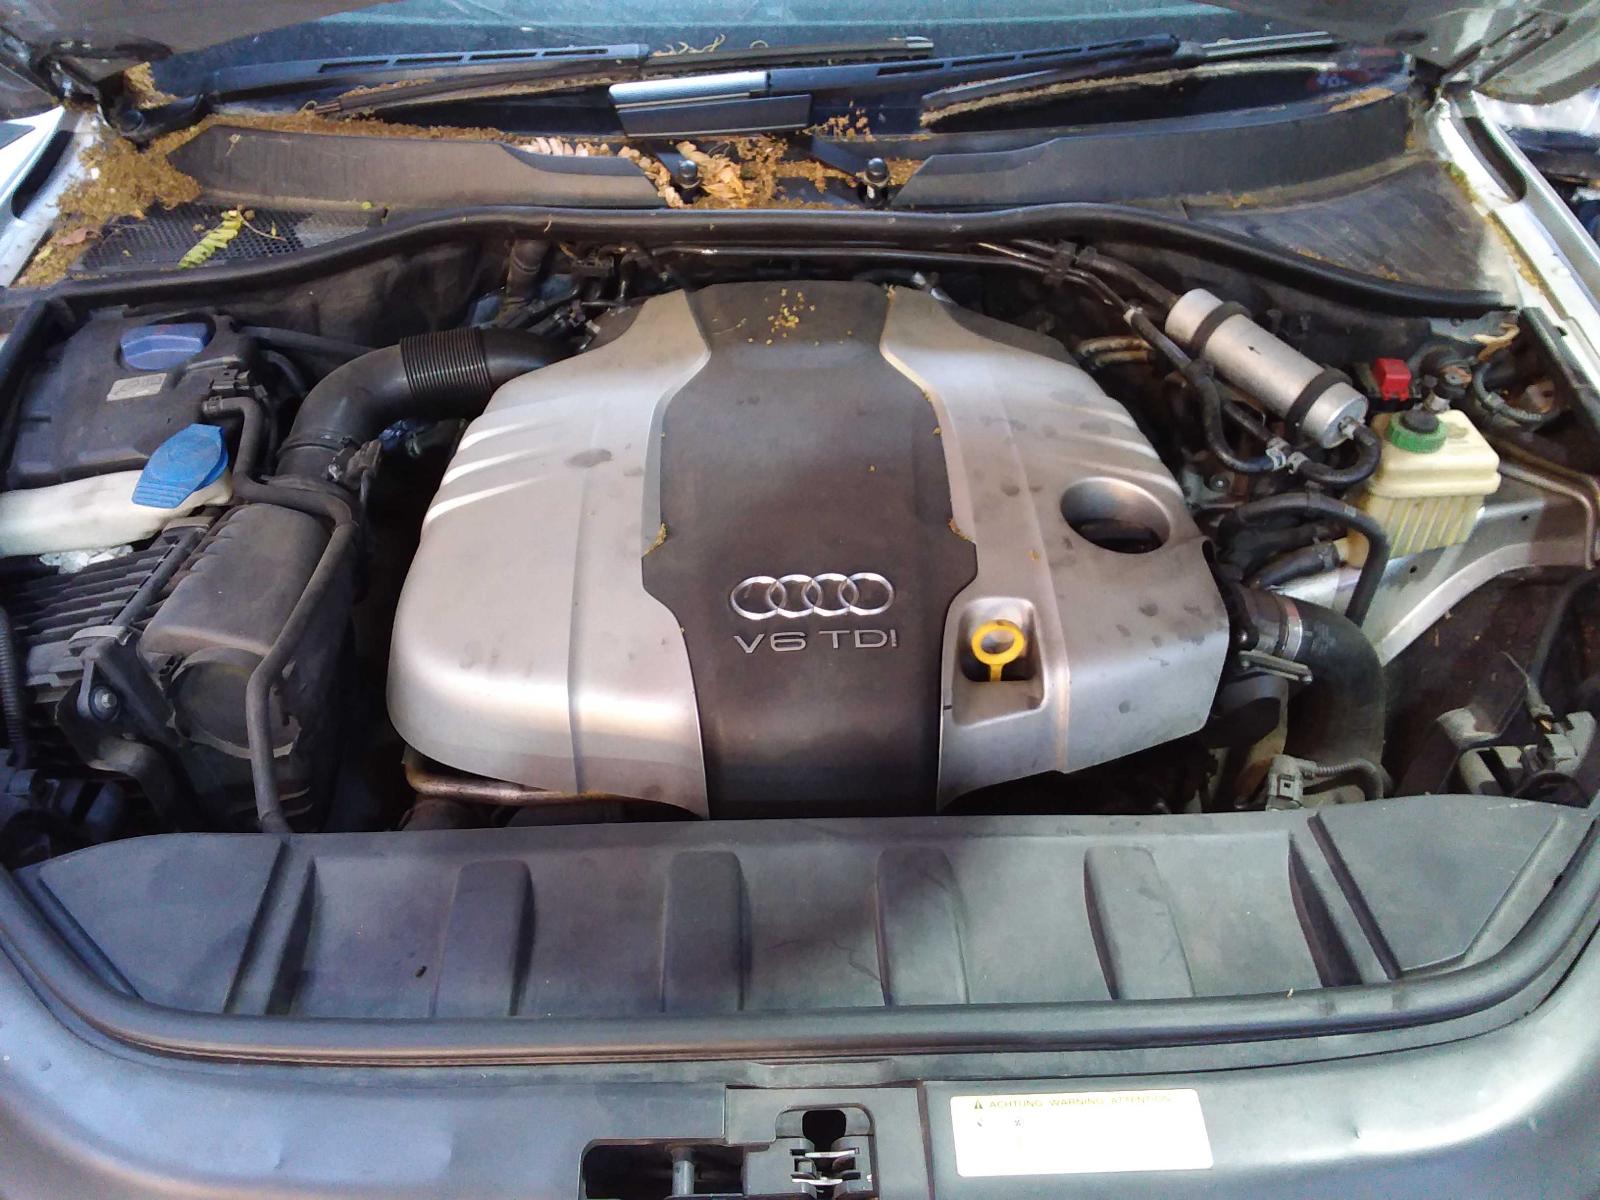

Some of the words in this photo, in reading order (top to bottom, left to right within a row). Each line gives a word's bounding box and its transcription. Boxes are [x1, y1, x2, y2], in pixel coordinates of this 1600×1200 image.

[733, 630, 807, 654] V6
[819, 629, 898, 649] TDI
[988, 1100, 1043, 1109] ACHTUNG
[1049, 1097, 1105, 1107] WARNING
